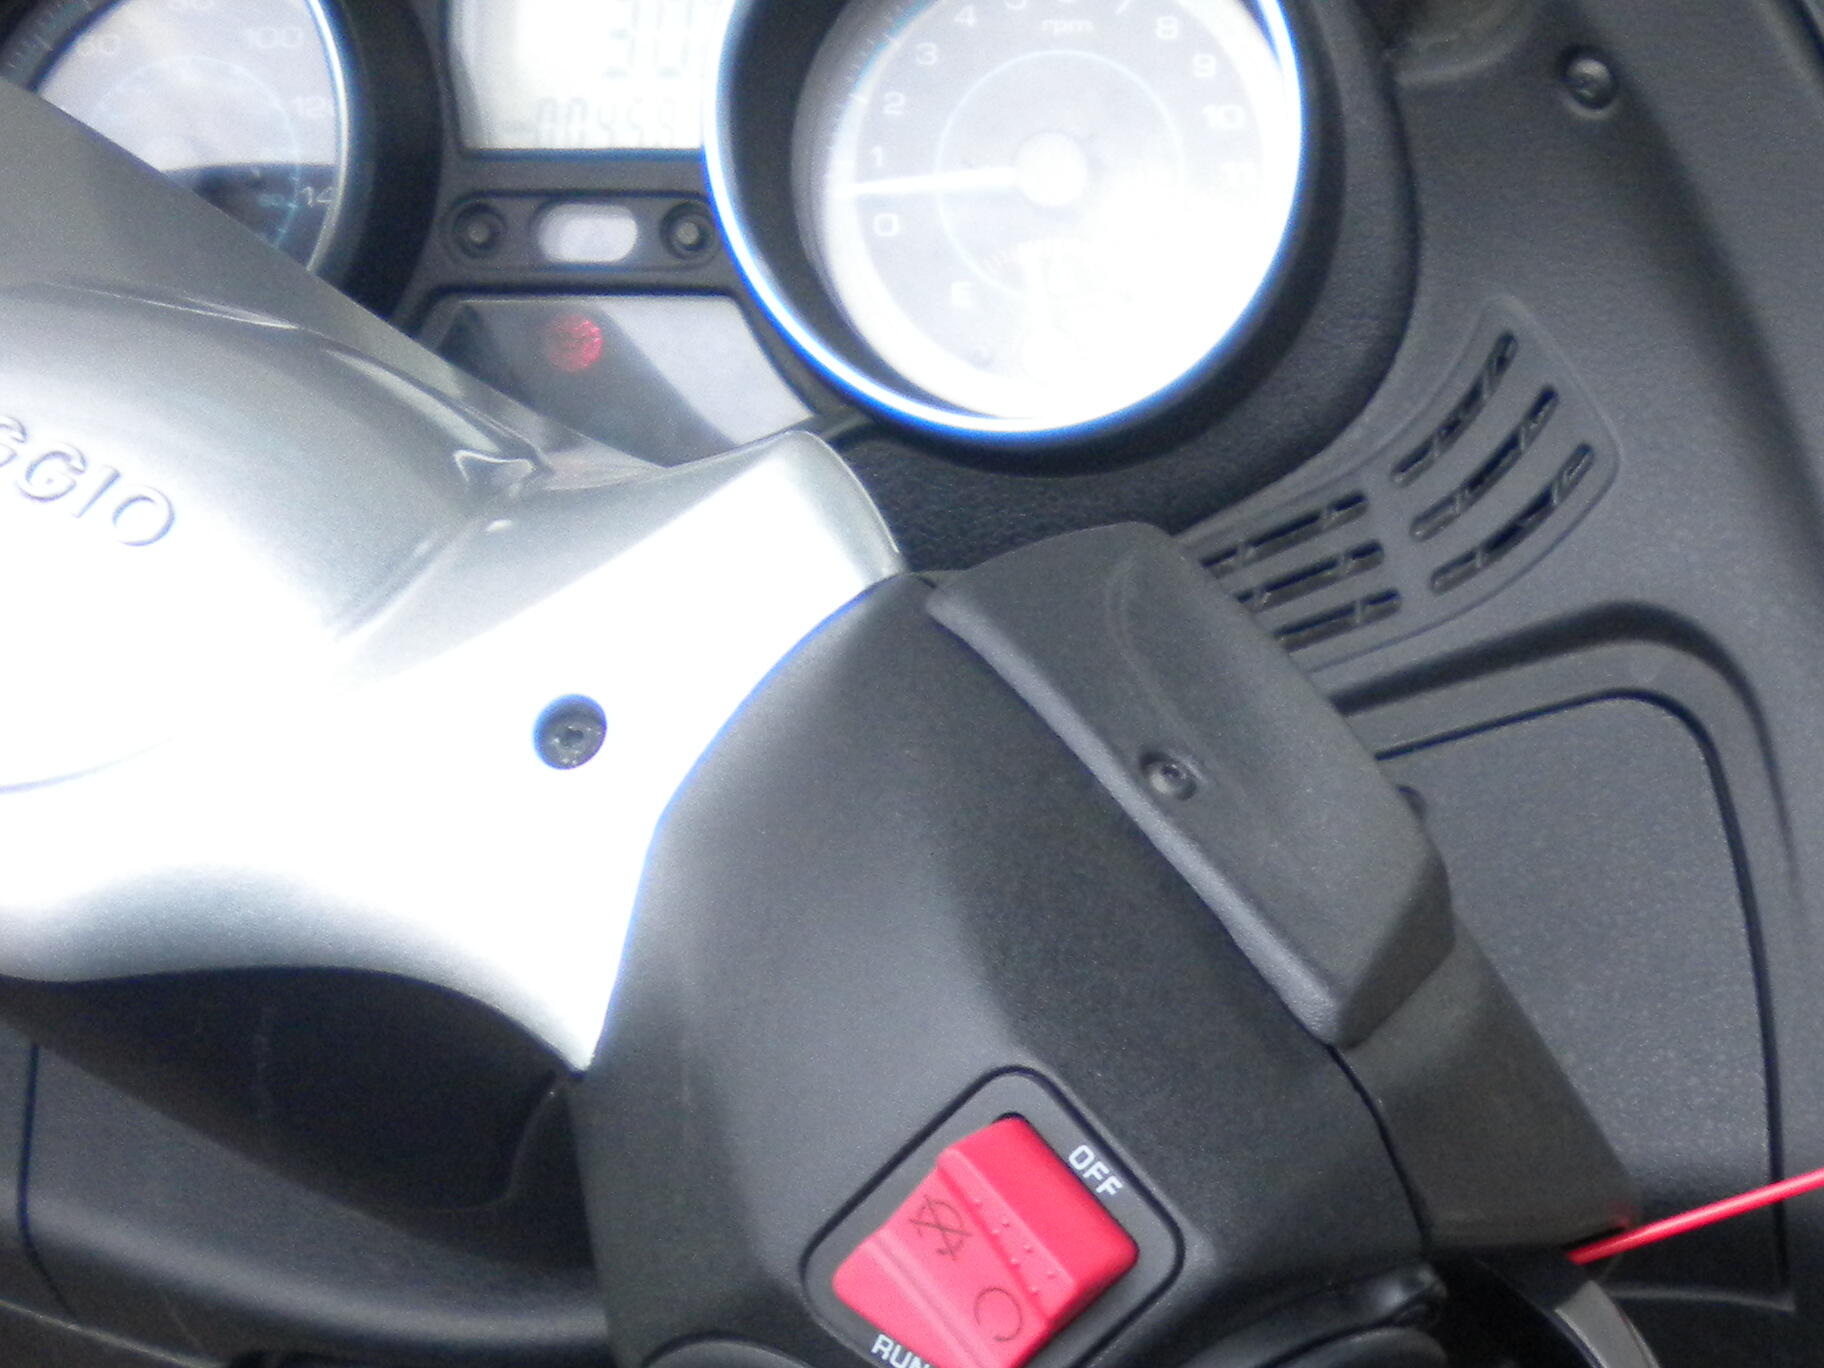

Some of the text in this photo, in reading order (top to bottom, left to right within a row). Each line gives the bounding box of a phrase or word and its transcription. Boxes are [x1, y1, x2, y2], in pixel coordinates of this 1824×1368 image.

[954, 5, 978, 28] 4
[1041, 19, 1095, 36] rpm
[1154, 15, 1181, 41] 8
[915, 42, 940, 66] 3
[1192, 53, 1218, 79] 9
[882, 91, 907, 116] 2
[1202, 105, 1246, 130] 10
[869, 145, 885, 168] 1
[872, 213, 900, 238] 0
[1068, 1144, 1123, 1195] OFF
